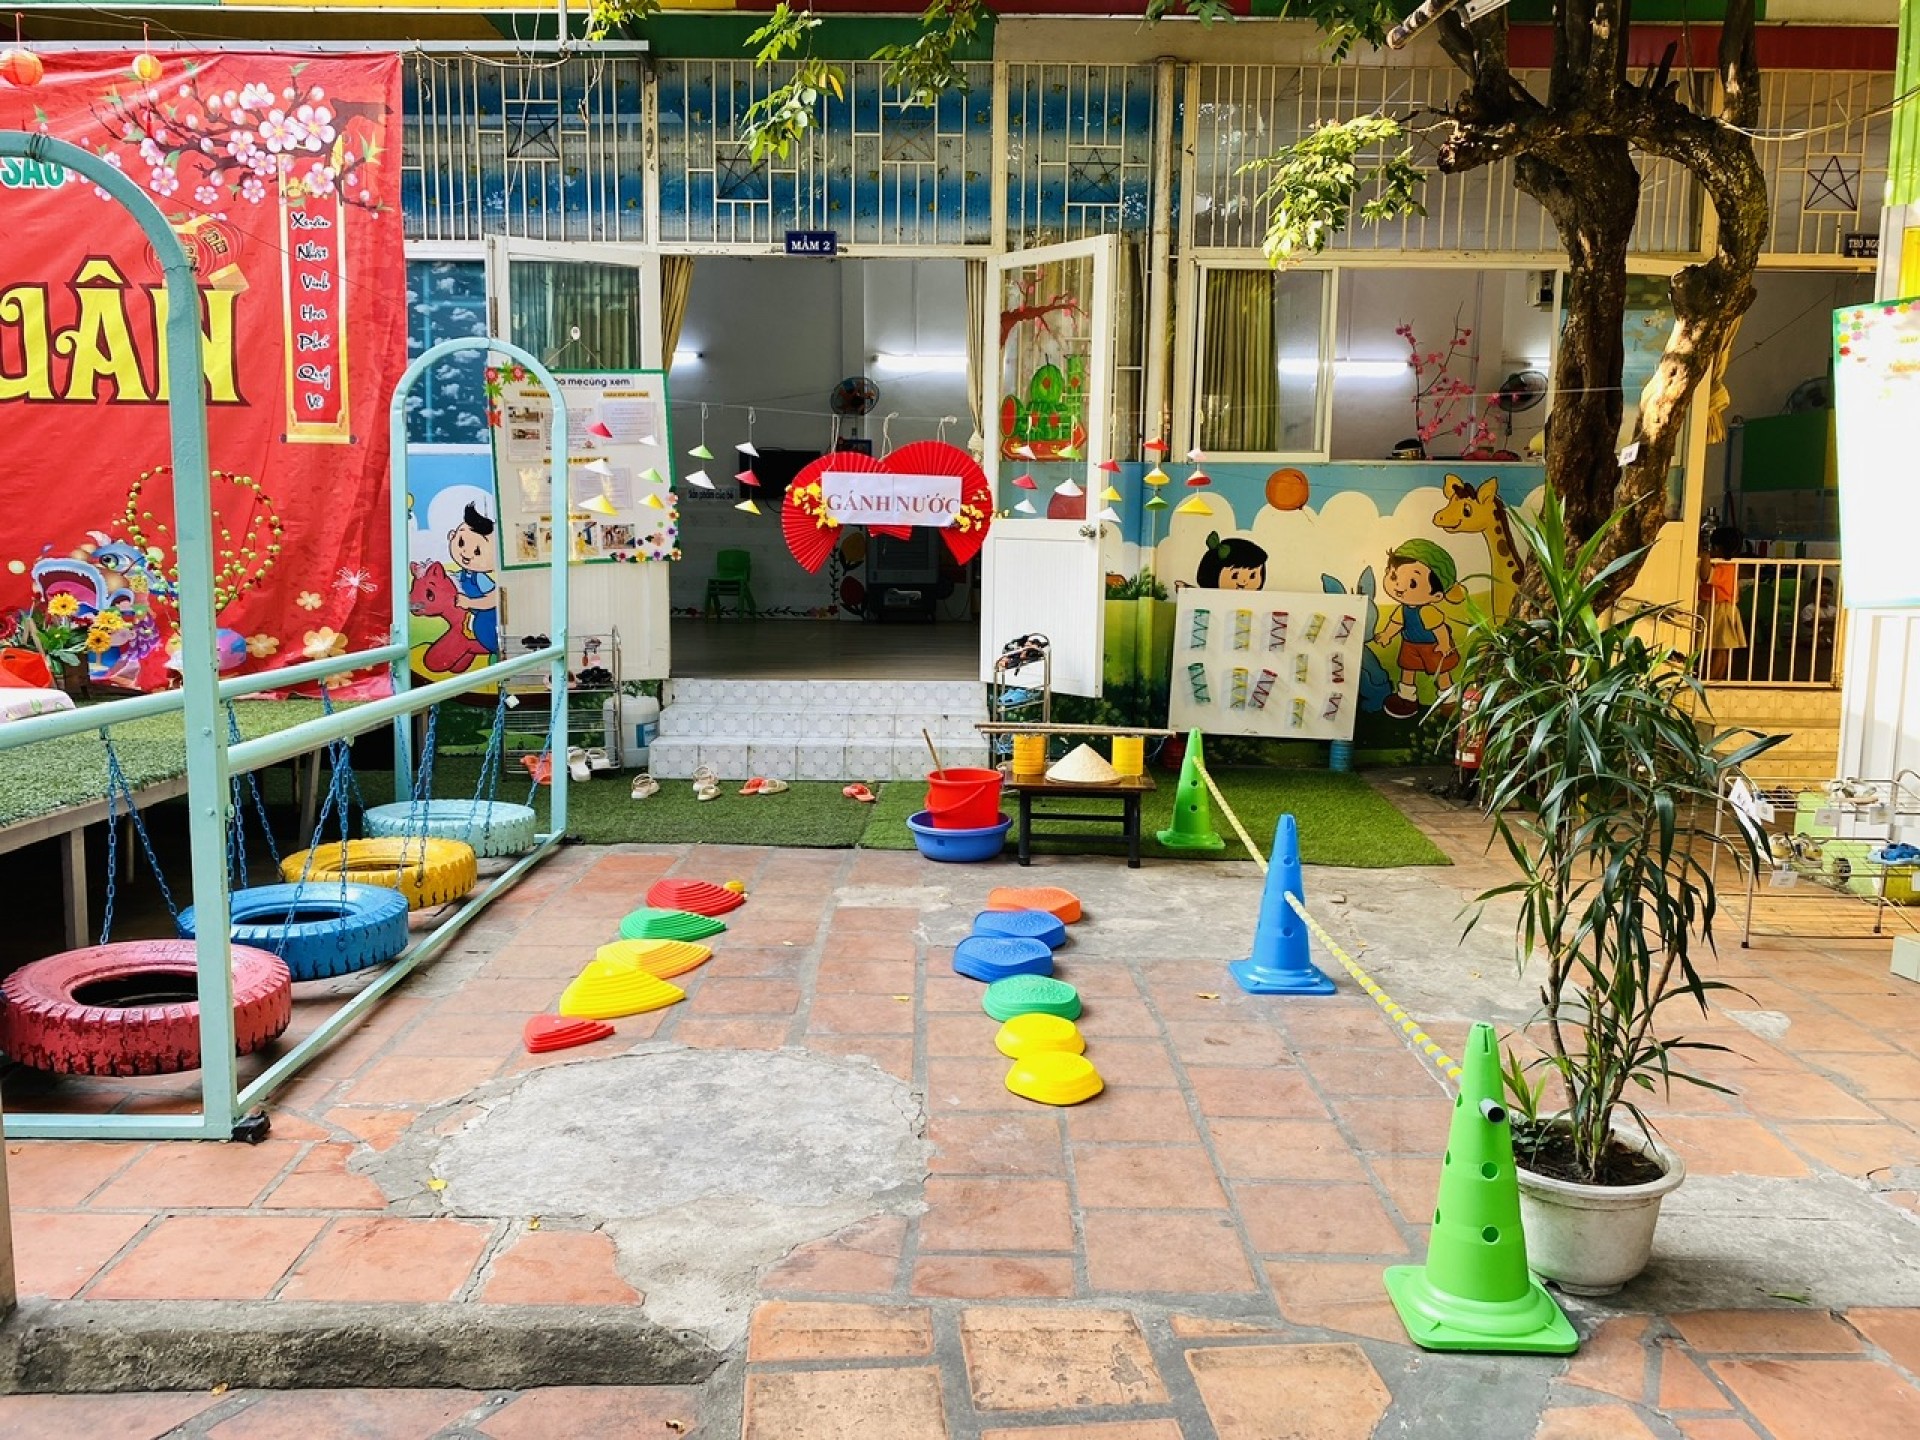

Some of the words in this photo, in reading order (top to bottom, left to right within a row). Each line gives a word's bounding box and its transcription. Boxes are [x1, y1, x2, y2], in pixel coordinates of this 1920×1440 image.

[823, 241, 830, 250] 2
[302, 271, 330, 290] Vinh
[301, 305, 327, 321] Hoa
[609, 378, 630, 386] xem
[827, 490, 890, 512] GÁNH
[896, 493, 960, 514] NƯỚC
